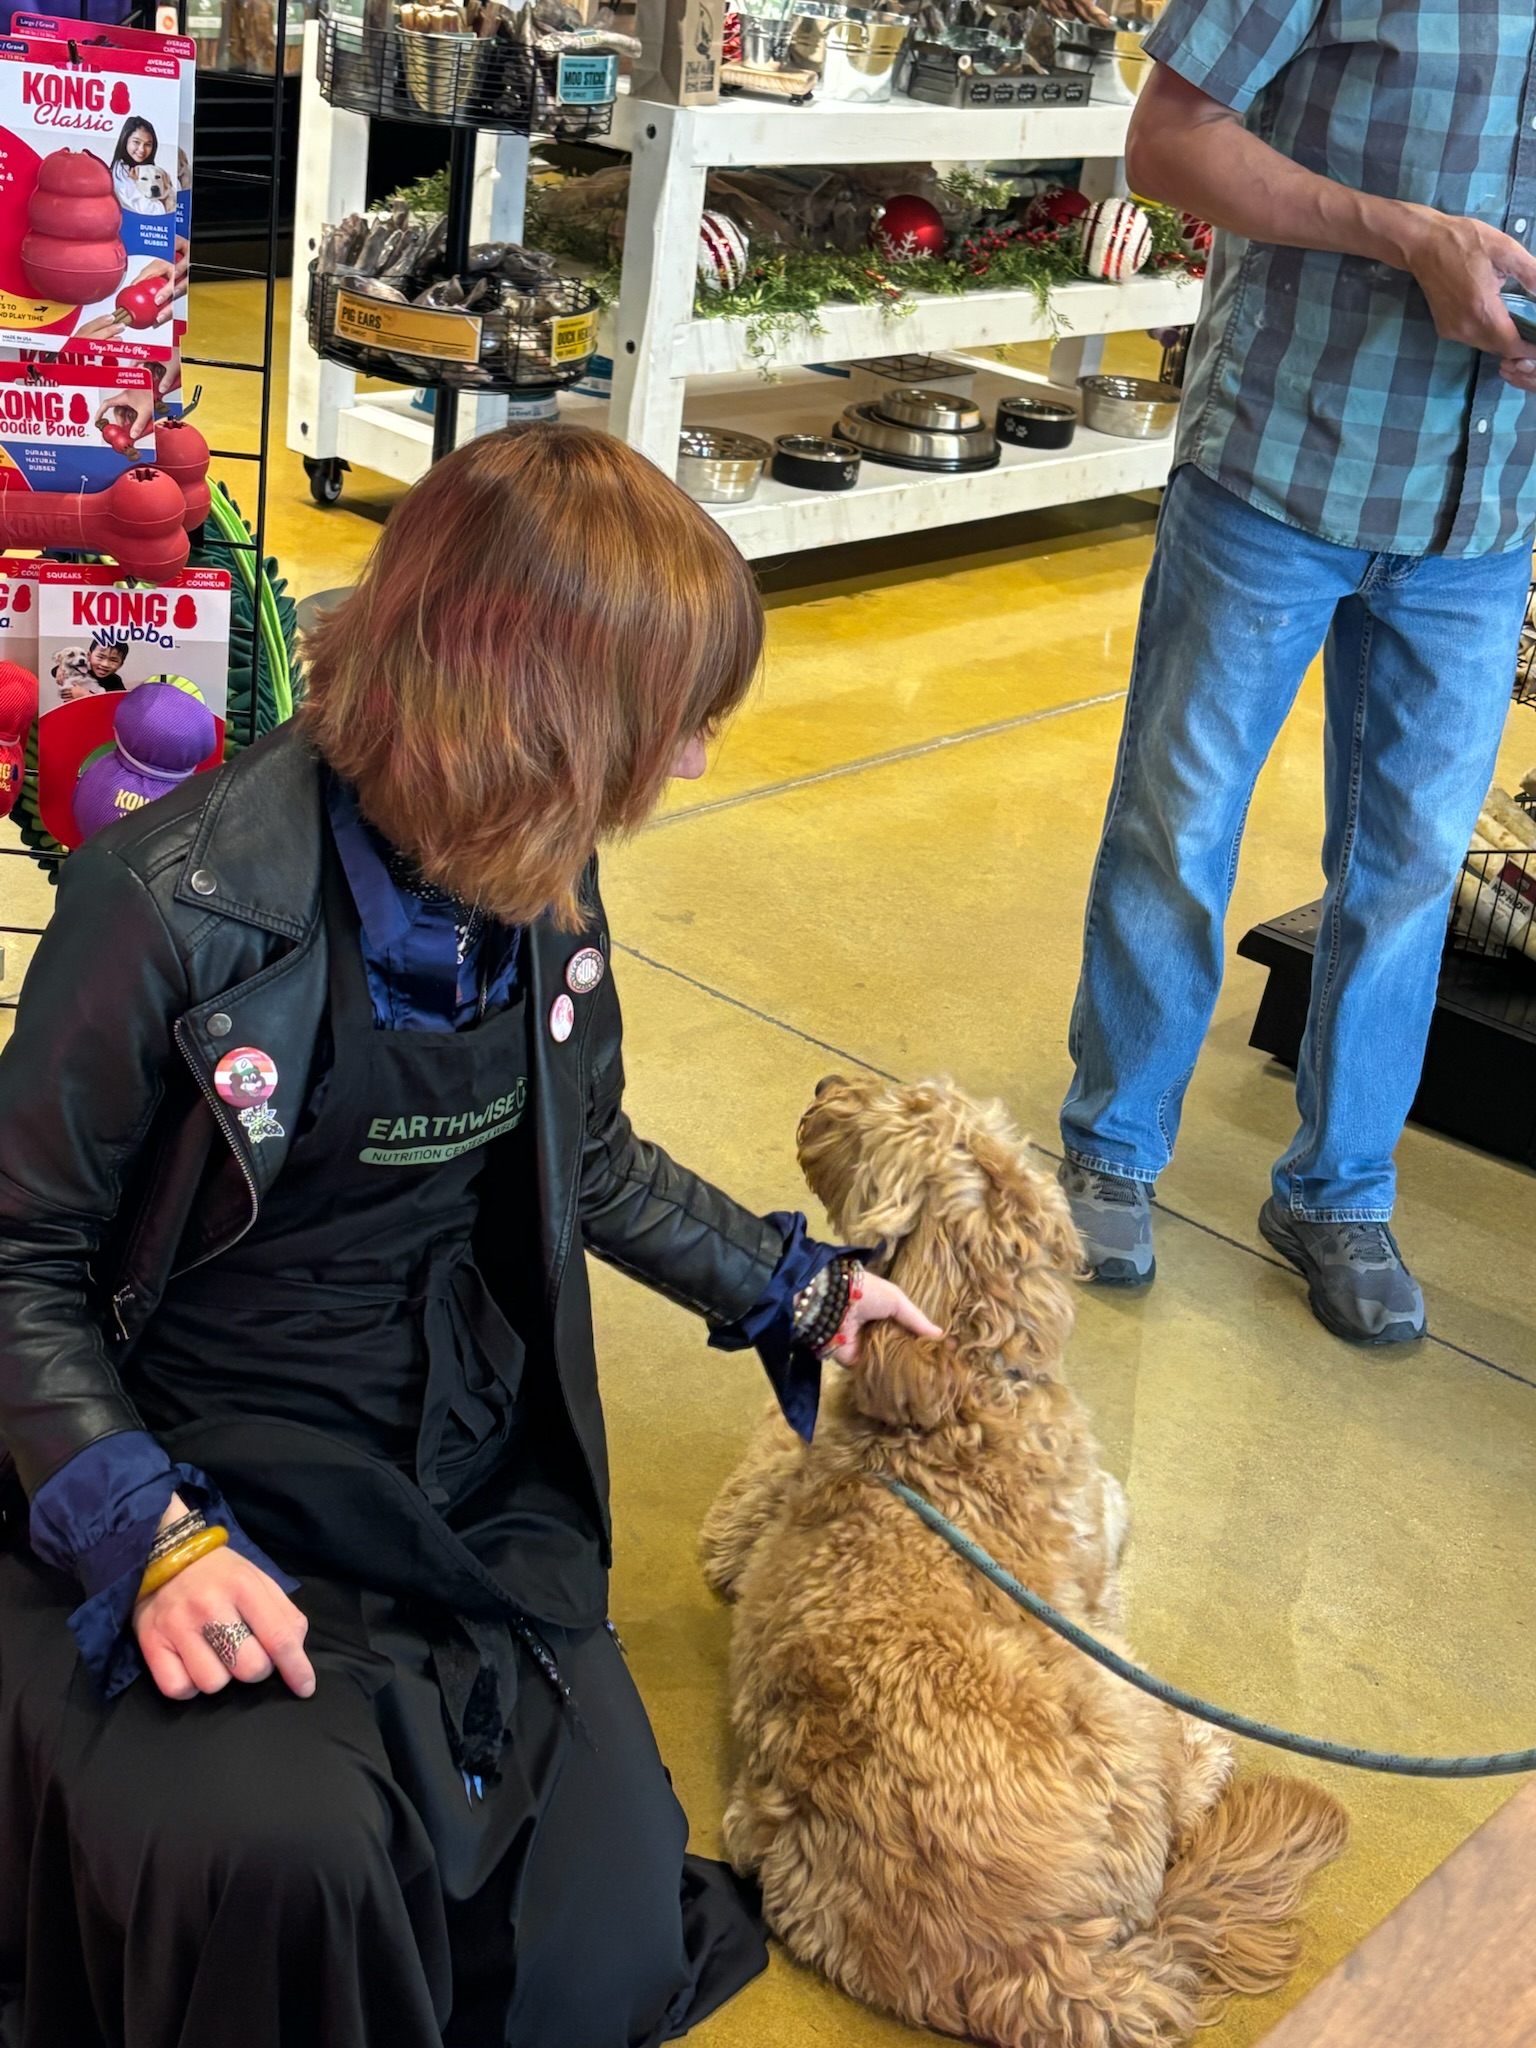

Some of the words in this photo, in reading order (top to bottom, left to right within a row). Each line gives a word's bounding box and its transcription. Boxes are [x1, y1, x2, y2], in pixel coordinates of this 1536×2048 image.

[166, 40, 190, 48] AVERAGE
[163, 46, 190, 56] CHEWERS
[147, 59, 175, 67] AVERAGE
[144, 66, 175, 75] CHEWERS
[564, 71, 582, 86] MOO
[22, 71, 105, 112] KONG
[34, 103, 114, 132] Classic
[140, 224, 168, 233] DURABLE
[140, 232, 168, 240] NATURAL
[144, 239, 168, 247] RUBBER
[9, 312, 26, 320] PLAY
[27, 314, 44, 322] TIME
[342, 306, 356, 321] PIG
[357, 311, 382, 329] EARS
[558, 330, 575, 346] DUCK
[89, 342, 106, 353] Dogs
[107, 344, 124, 352] Need
[0, 418, 41, 435] oodie
[25, 449, 57, 457] DURABLE
[46, 571, 82, 579] SQUEAKS
[194, 572, 218, 580] JOUET
[186, 580, 225, 588] COUINEUR
[72, 591, 167, 627] KONG
[92, 621, 174, 649] Wubba
[1491, 882, 1531, 916] NO-HDE
[367, 1091, 517, 1141] EARTHWISE
[372, 1148, 442, 1162] NUTRITION
[445, 1135, 484, 1157] CENTER
